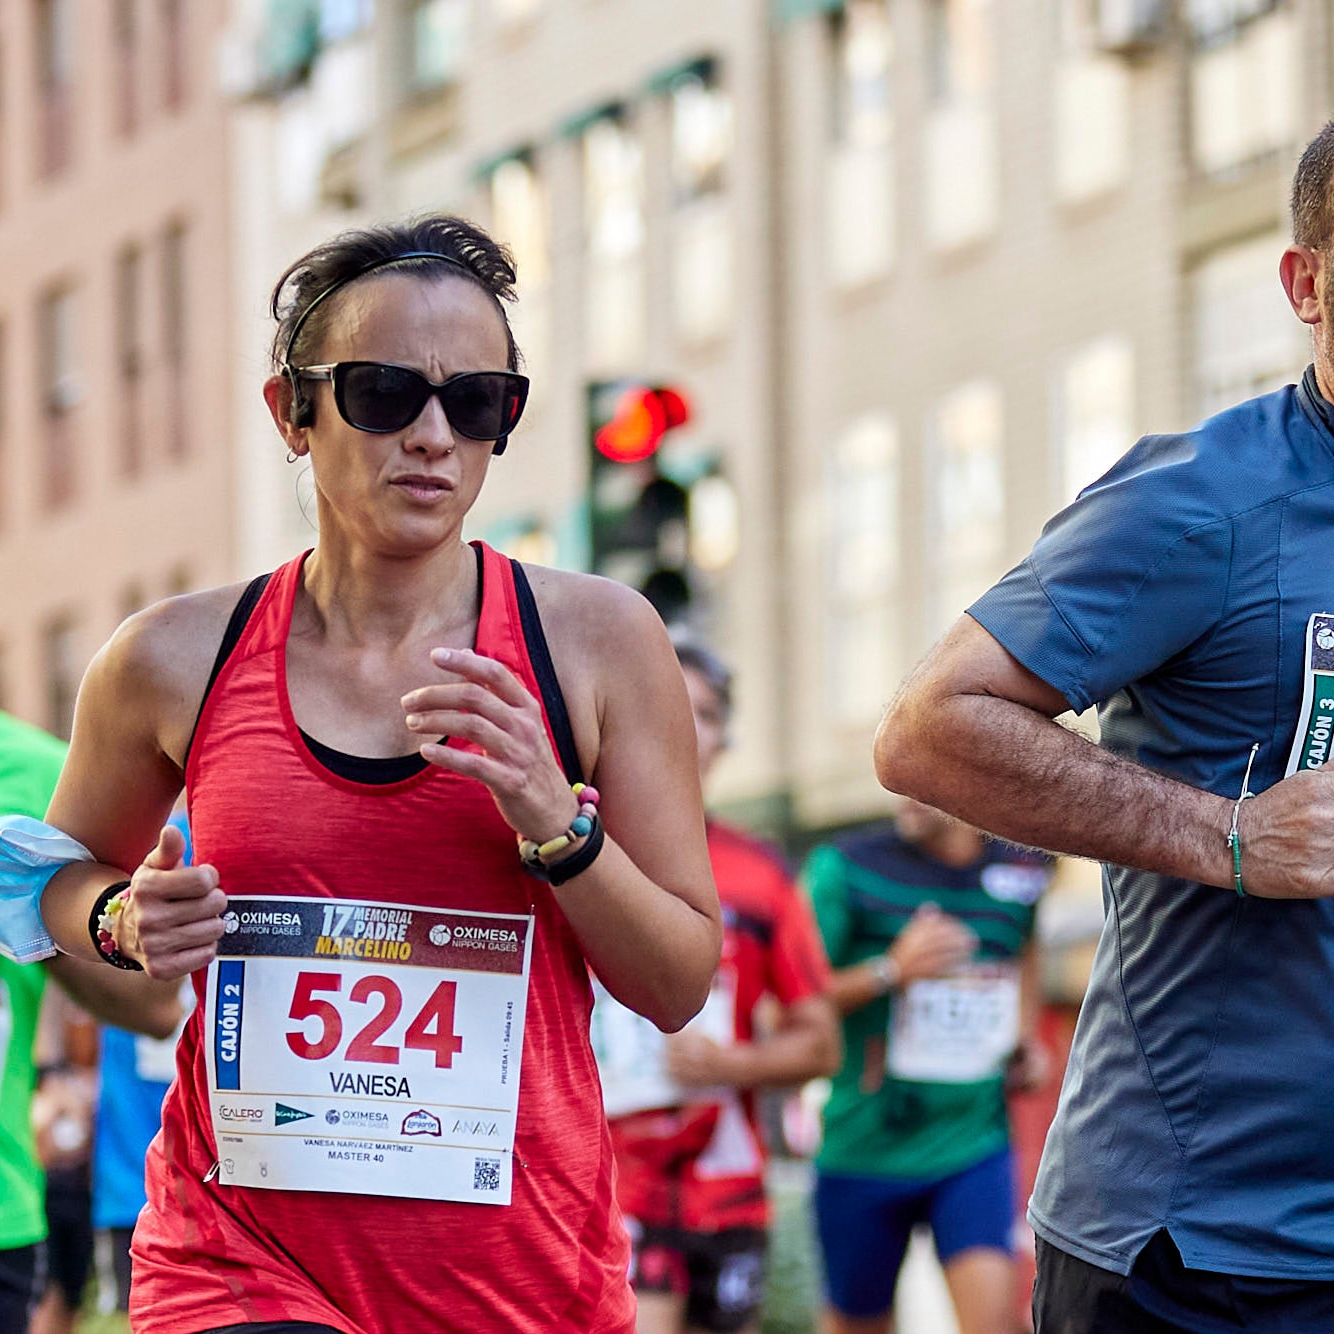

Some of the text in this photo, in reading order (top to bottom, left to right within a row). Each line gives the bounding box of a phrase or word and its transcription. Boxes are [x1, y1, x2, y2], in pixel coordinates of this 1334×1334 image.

[1306, 716, 1332, 770] CAJÓN
[240, 912, 302, 926] OXIMESA
[320, 905, 356, 937] 17
[354, 908, 413, 925] MEMORIAL
[240, 926, 301, 936] NIPPON GASES
[353, 921, 408, 942] PADRE
[453, 926, 518, 942] OXIMESA
[314, 936, 412, 960] MARCELINO
[452, 940, 518, 952] NIPPON GASES
[218, 984, 240, 1062] CAJÓN 2
[285, 971, 462, 1069] 524
[330, 1072, 411, 1098] VANESA
[221, 1108, 263, 1119] CALERO
[342, 1110, 388, 1121] OXIMESA
[328, 1151, 384, 1162] MASTER 40
